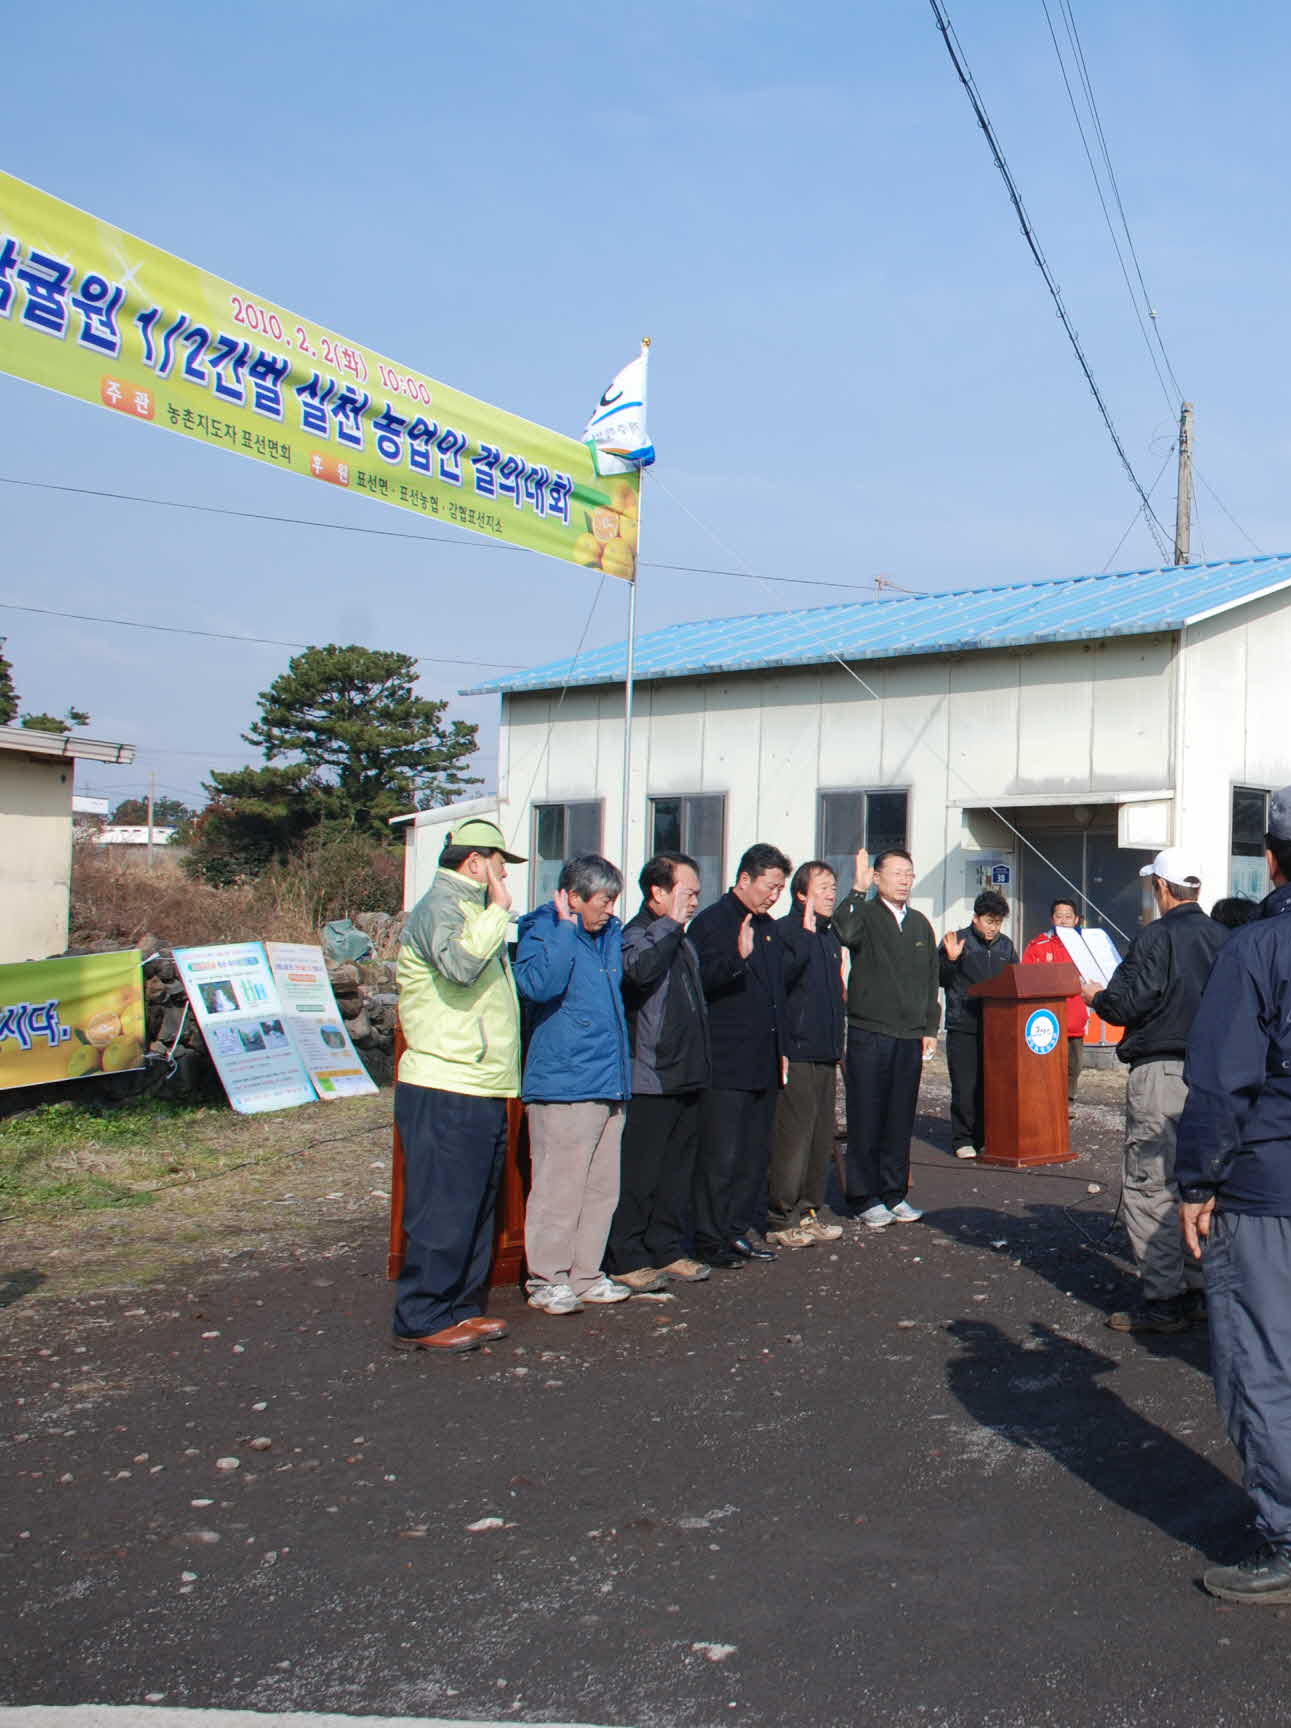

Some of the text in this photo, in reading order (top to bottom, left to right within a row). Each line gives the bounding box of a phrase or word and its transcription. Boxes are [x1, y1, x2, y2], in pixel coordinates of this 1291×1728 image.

[379, 365, 430, 405] 10:00
[135, 306, 290, 423] 1/2간벌
[296, 370, 369, 449] 실천
[372, 401, 467, 486] 농업인
[471, 442, 573, 525] 결의대회
[167, 402, 238, 445] 농촌지도자
